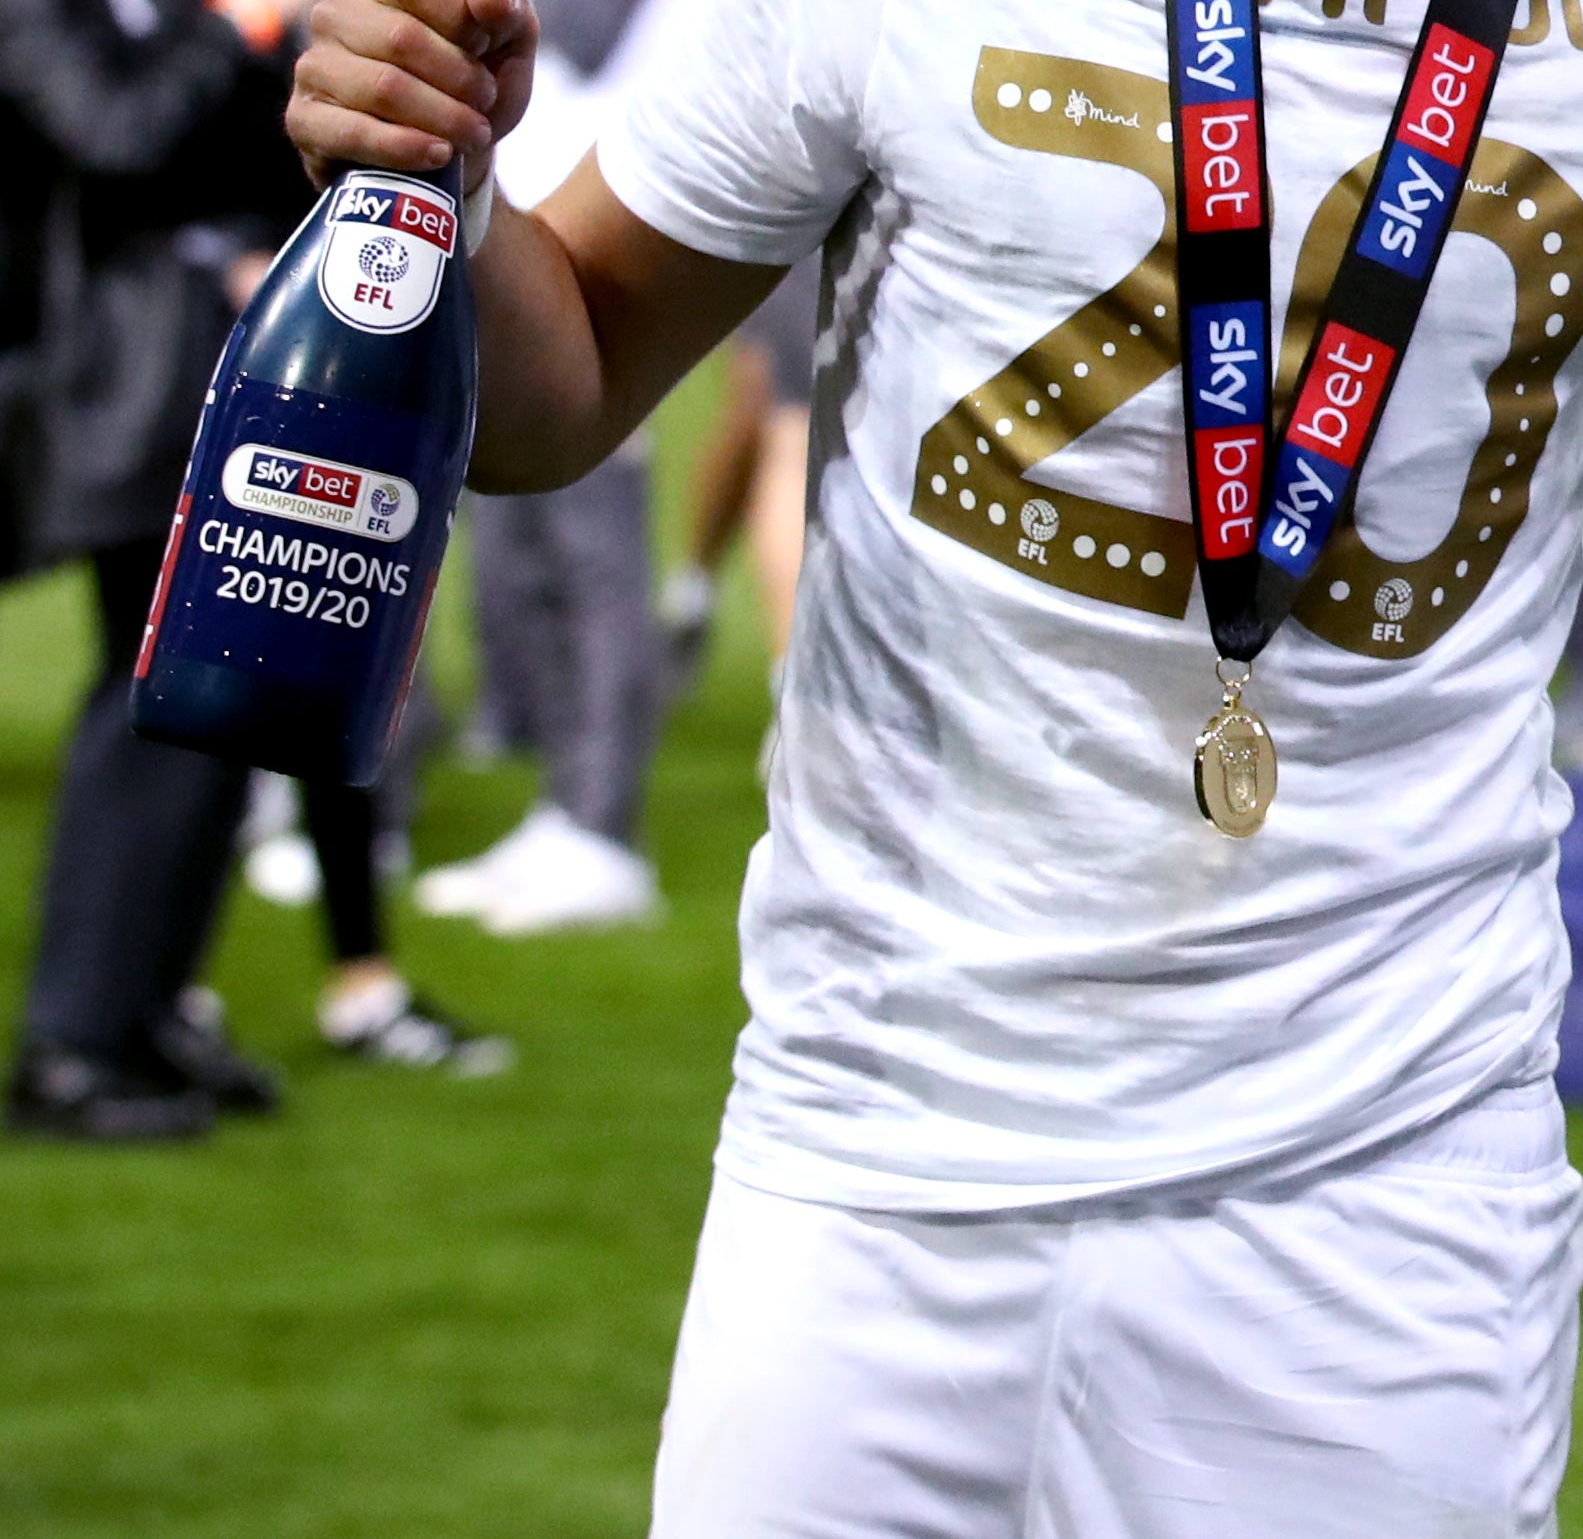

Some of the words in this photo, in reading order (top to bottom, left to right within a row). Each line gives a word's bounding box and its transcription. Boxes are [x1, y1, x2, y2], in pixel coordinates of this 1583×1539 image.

[1086, 100, 1141, 129] mind
[1407, 43, 1475, 148] bet
[1200, 113, 1250, 218] bet
[336, 188, 392, 223] sky
[401, 196, 451, 241] bet
[1378, 156, 1444, 258] sky
[353, 283, 394, 311] EFL
[1200, 317, 1258, 416] sky
[1298, 342, 1374, 448] bet
[242, 487, 354, 525] CHAMPIONSHIP
[254, 458, 300, 491] sky
[305, 467, 354, 500] bet
[1212, 437, 1257, 544] bet
[1272, 457, 1335, 557] sky
[367, 516, 391, 535] EFL
[1017, 539, 1049, 566] EFL
[199, 519, 411, 597] CHAMPIONS
[216, 565, 371, 629] 2019/20
[1371, 623, 1406, 644] EFL
